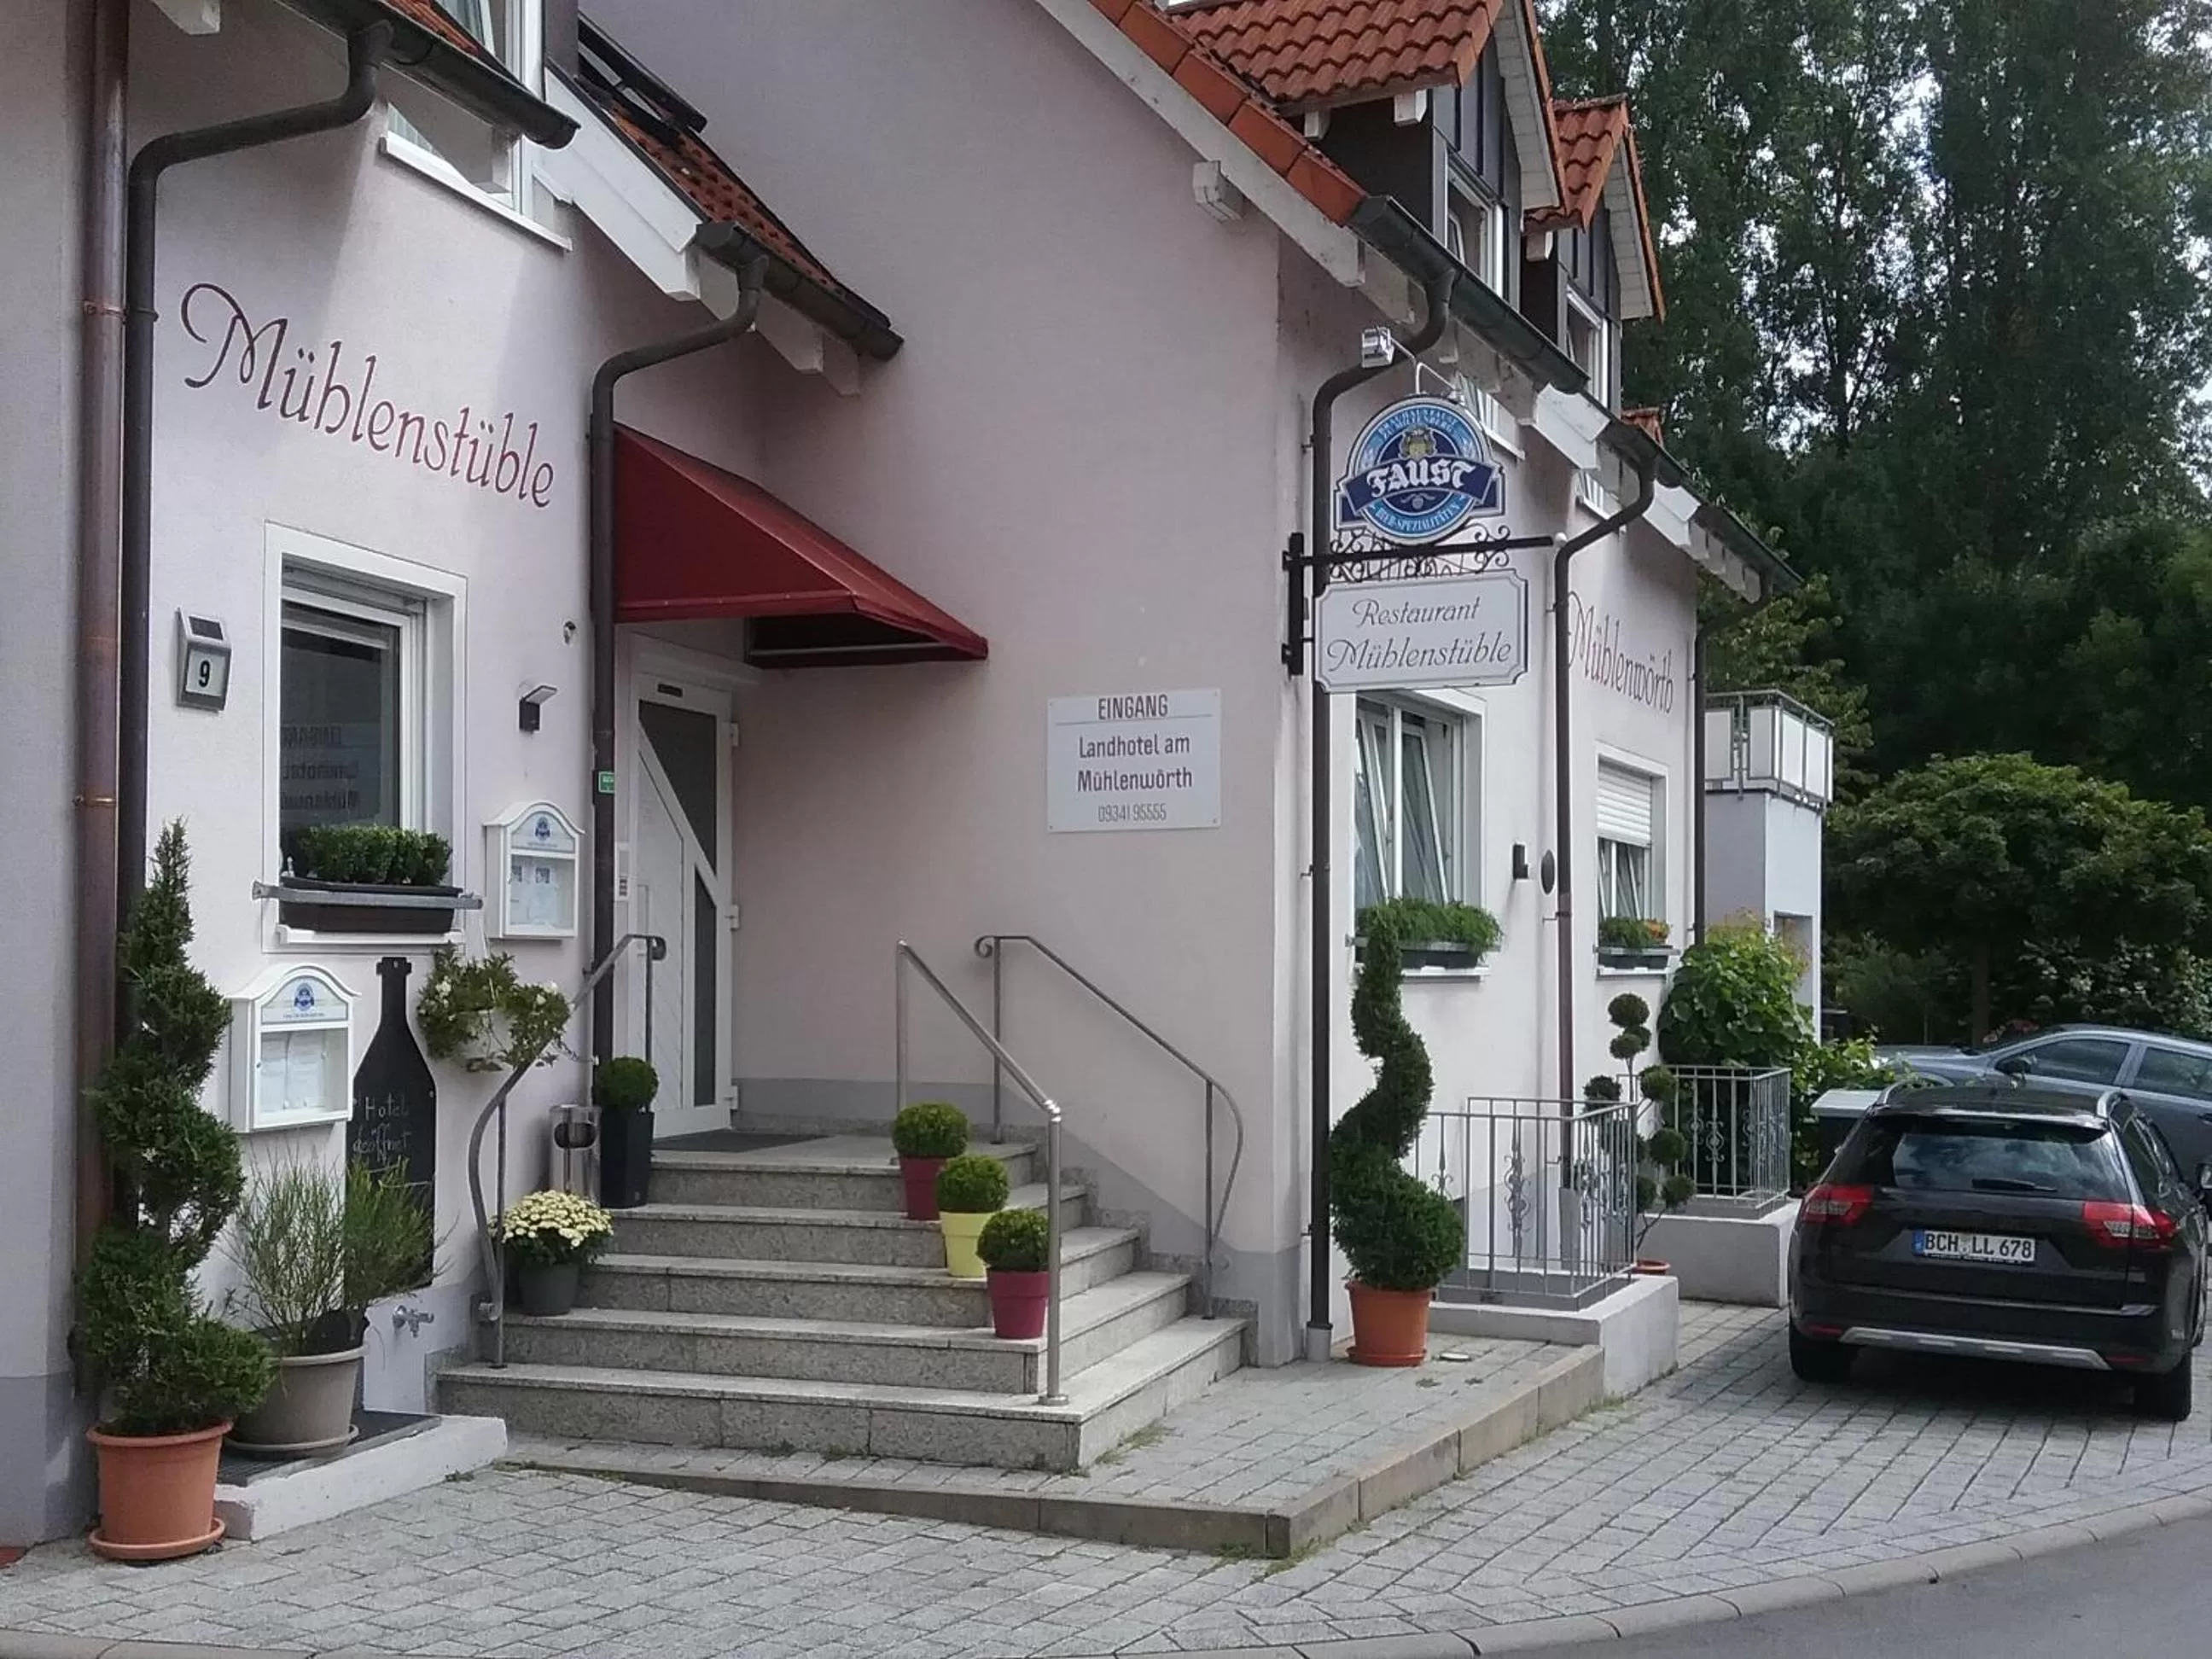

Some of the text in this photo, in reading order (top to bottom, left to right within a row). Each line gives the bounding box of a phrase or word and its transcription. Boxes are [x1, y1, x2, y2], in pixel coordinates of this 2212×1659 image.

[180, 283, 555, 508] Mühlenstüble
[1366, 457, 1476, 498] FAUST
[1352, 596, 1481, 628] Restaurant
[1326, 631, 1512, 672] Mühlenstüble
[198, 660, 211, 688] 9
[1097, 694, 1168, 720] EINGANG
[1079, 734, 1190, 758] Landhotel am
[1077, 766, 1193, 792] Mühlenwörth
[1925, 1233, 2032, 1259] BCH LL 678
